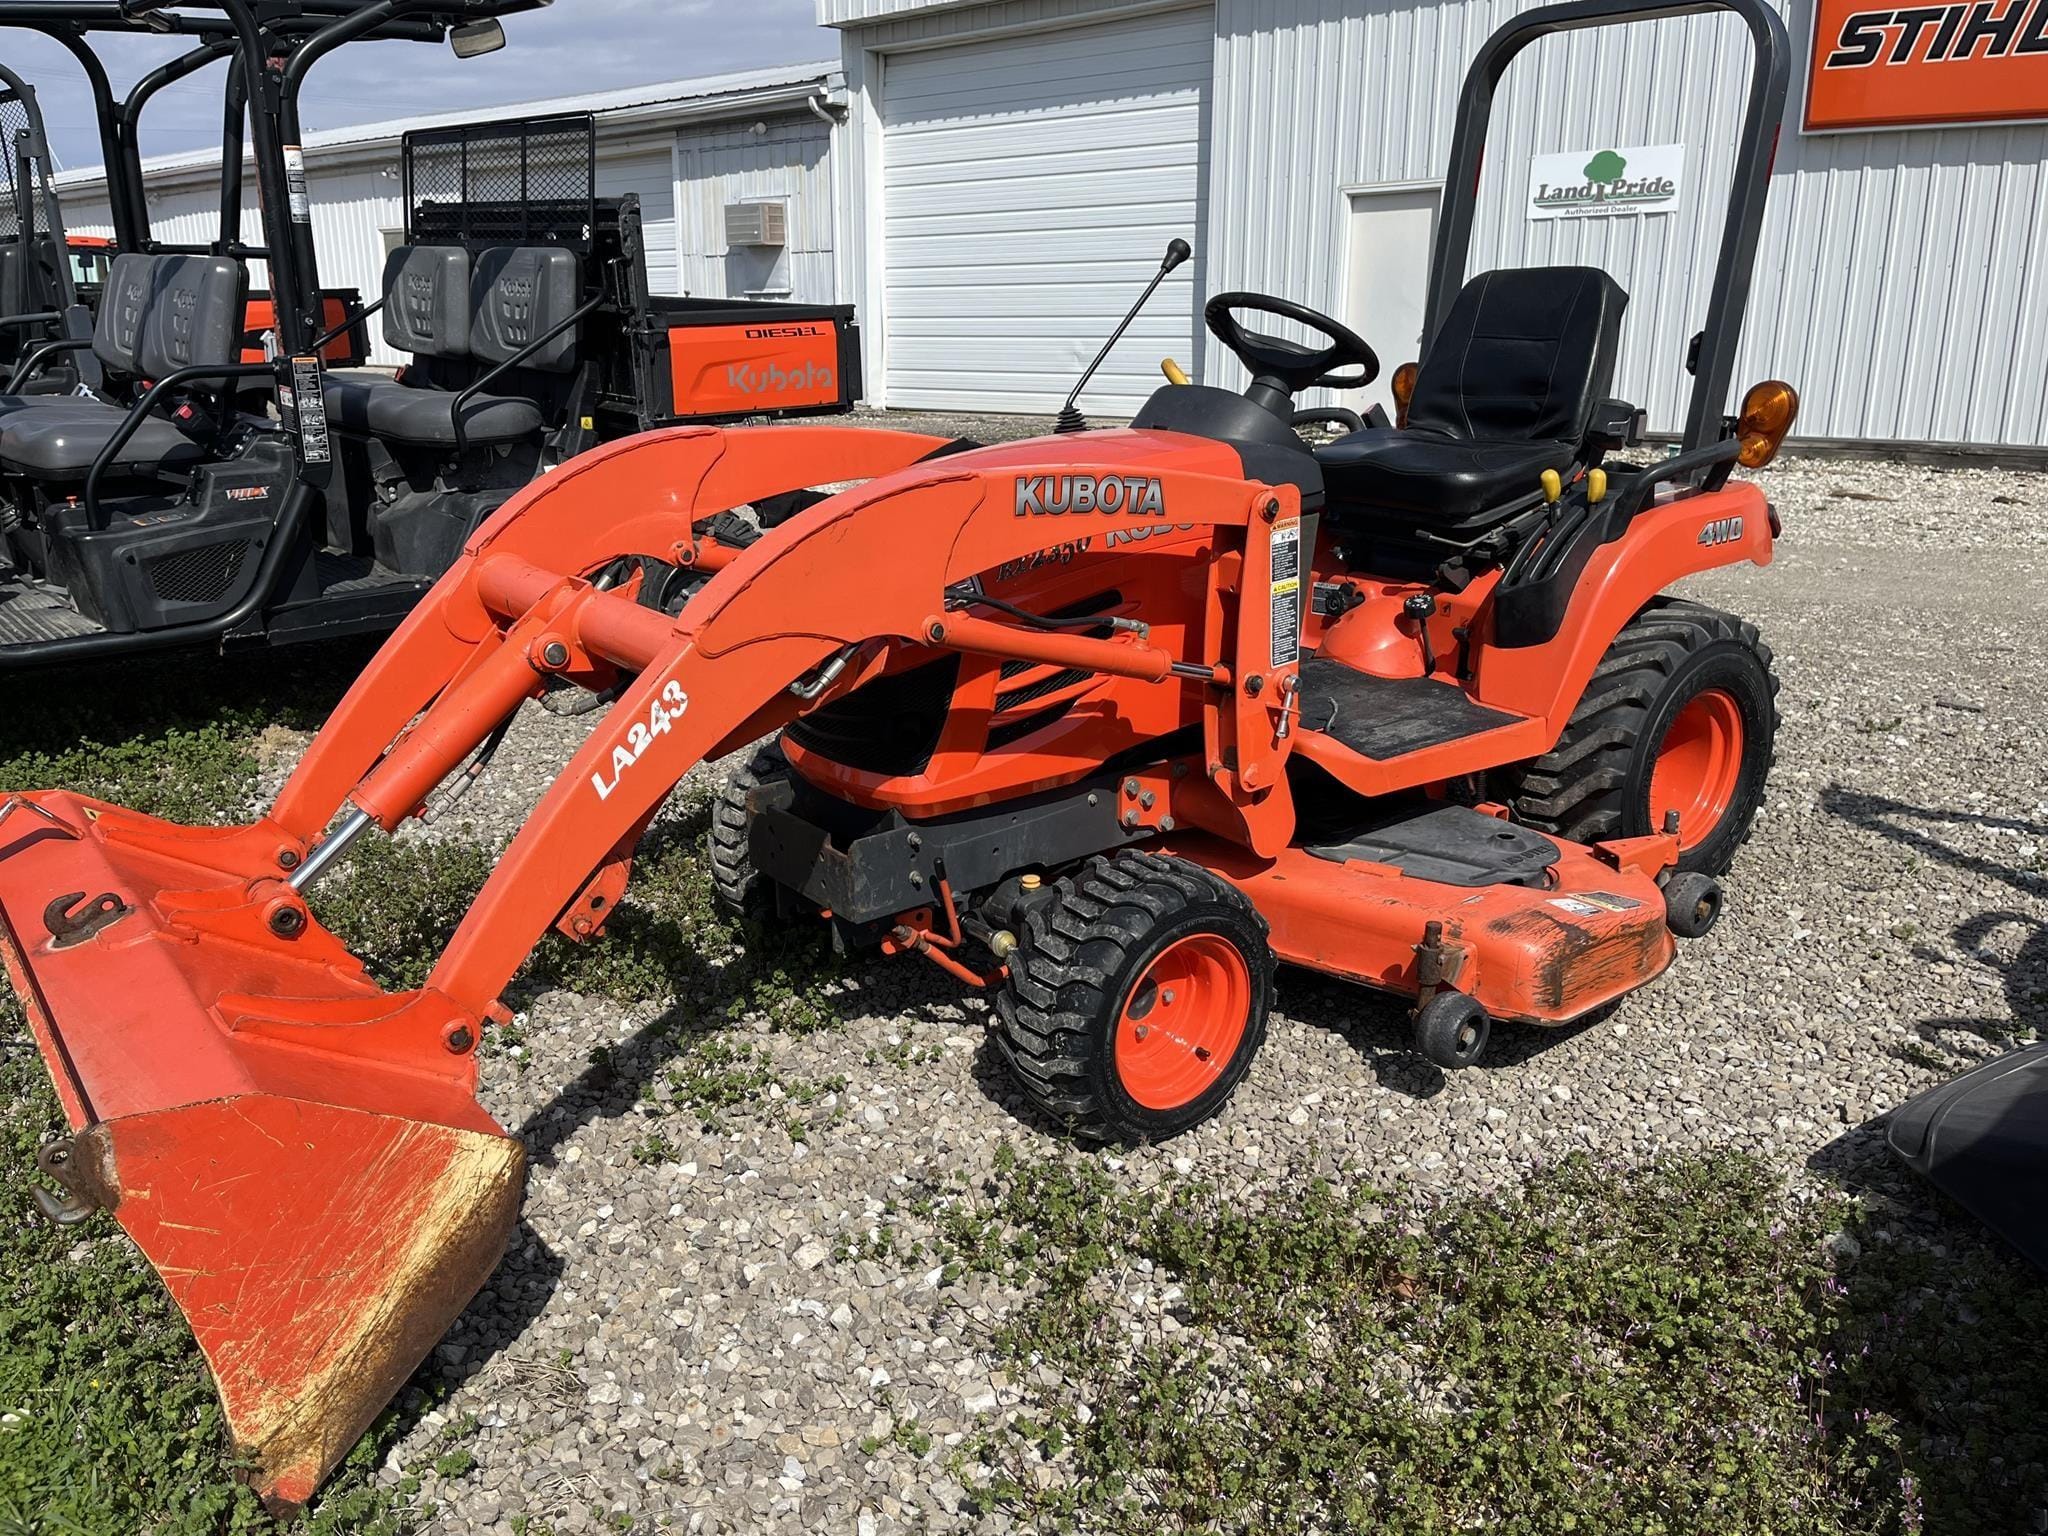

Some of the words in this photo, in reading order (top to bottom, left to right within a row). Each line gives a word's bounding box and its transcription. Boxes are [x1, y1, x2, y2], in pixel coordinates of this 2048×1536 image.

[1537, 180, 1593, 200] Land
[1609, 176, 1675, 197] Pride
[1564, 206, 1609, 216] Authorized
[1611, 205, 1638, 213] Dealer
[745, 326, 826, 339] DIESEL
[727, 358, 833, 393] Kubota
[1015, 475, 1165, 516] KUBOTA
[1697, 515, 1744, 547] 4WD
[591, 680, 688, 800] LA243
